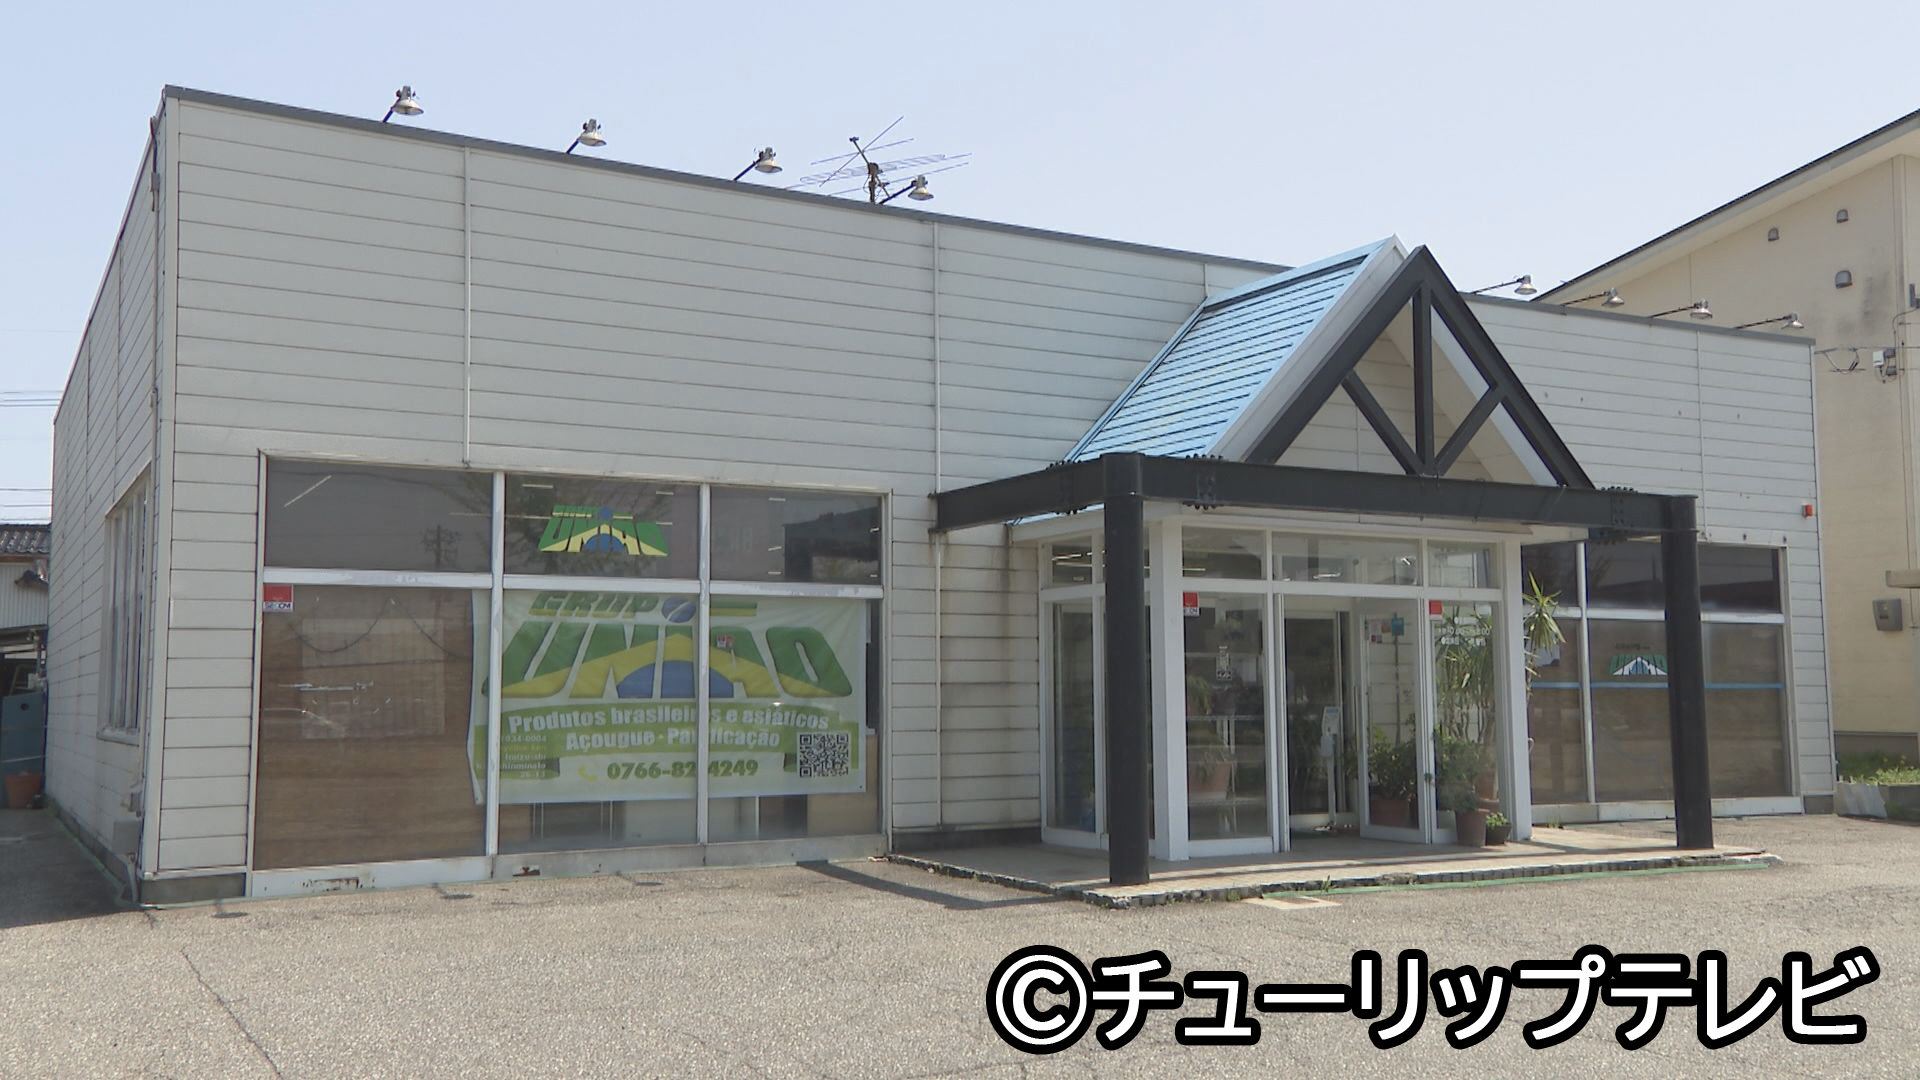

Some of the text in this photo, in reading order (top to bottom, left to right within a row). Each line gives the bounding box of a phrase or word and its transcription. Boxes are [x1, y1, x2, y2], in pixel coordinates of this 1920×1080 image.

[508, 709, 606, 735] Produtos
[726, 709, 738, 723] e
[566, 730, 656, 752] Açougue
